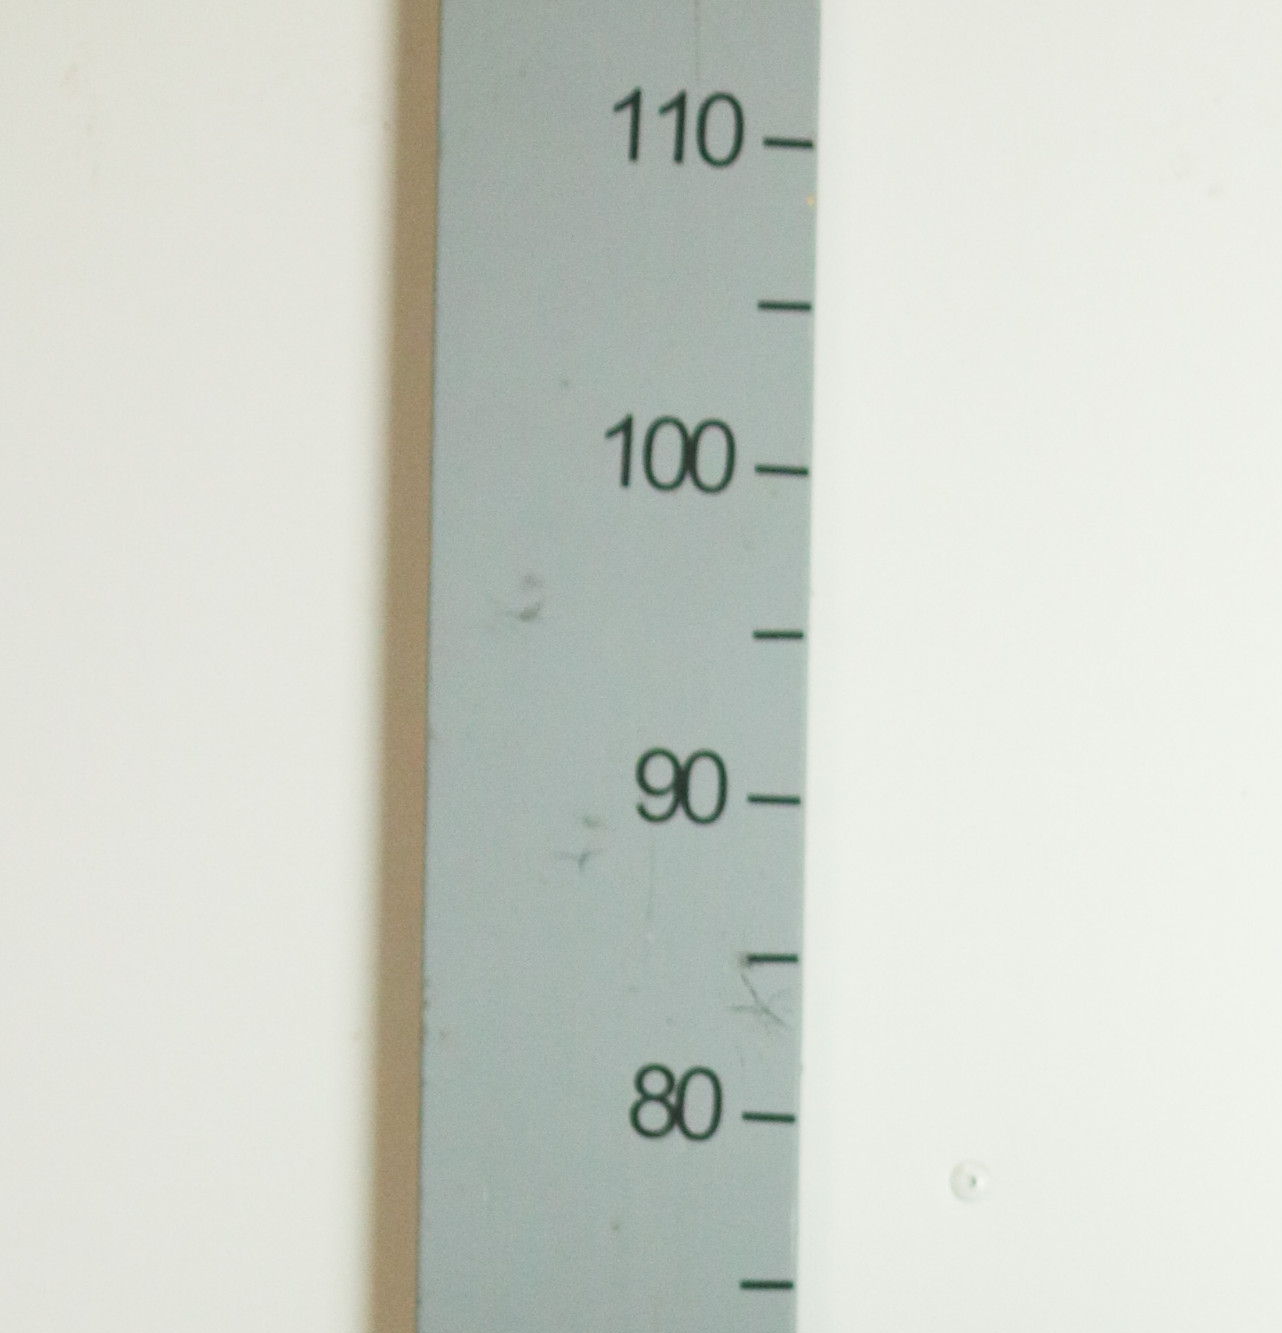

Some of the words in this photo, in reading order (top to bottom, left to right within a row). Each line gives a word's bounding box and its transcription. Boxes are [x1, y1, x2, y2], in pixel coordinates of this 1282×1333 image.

[614, 88, 744, 168] 110
[606, 415, 736, 494] 100
[636, 749, 727, 825] 90
[630, 1064, 722, 1141] 80
